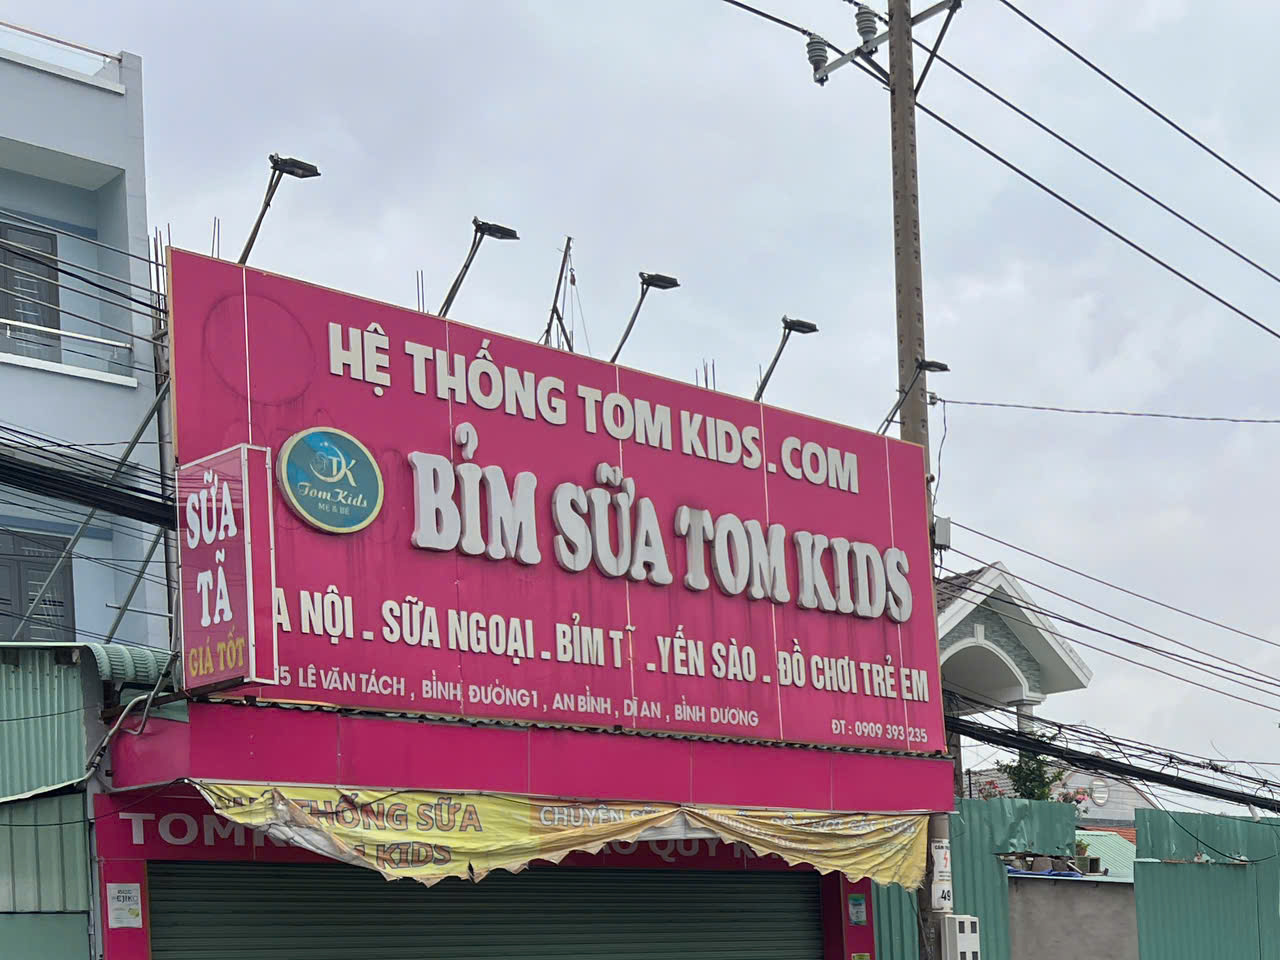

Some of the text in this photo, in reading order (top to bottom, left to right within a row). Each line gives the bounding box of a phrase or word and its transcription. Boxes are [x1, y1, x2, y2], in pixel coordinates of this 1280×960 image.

[328, 322, 391, 397] HỆ
[405, 338, 567, 425] THỐNG
[577, 384, 673, 452] TOM
[186, 469, 238, 549] SỮA
[298, 482, 367, 507] Tom Kids
[408, 421, 913, 623] BỈM SỮA TOM KIDS
[197, 548, 233, 628] TÃ
[189, 625, 245, 677] GIÁ TỐT
[300, 585, 354, 645] NỘI
[382, 596, 441, 649] SỮA
[448, 608, 535, 665] NGOẠI
[556, 613, 605, 667] BỈM
[656, 625, 706, 677] YẾN
[712, 638, 757, 683] SÀO
[777, 638, 807, 688] ĐỒ
[810, 655, 858, 694] CHƠI
[860, 655, 898, 699] TRẺ
[900, 668, 930, 702] EM
[299, 664, 317, 688] LÊ
[320, 667, 356, 691] VĂN
[553, 693, 575, 711] AN
[855, 720, 883, 738] 0909
[886, 724, 905, 741] 393
[908, 726, 928, 743] 235
[416, 793, 483, 832] SỮA
[540, 804, 625, 828] CHUYÊN
[376, 842, 452, 870] KIDS
